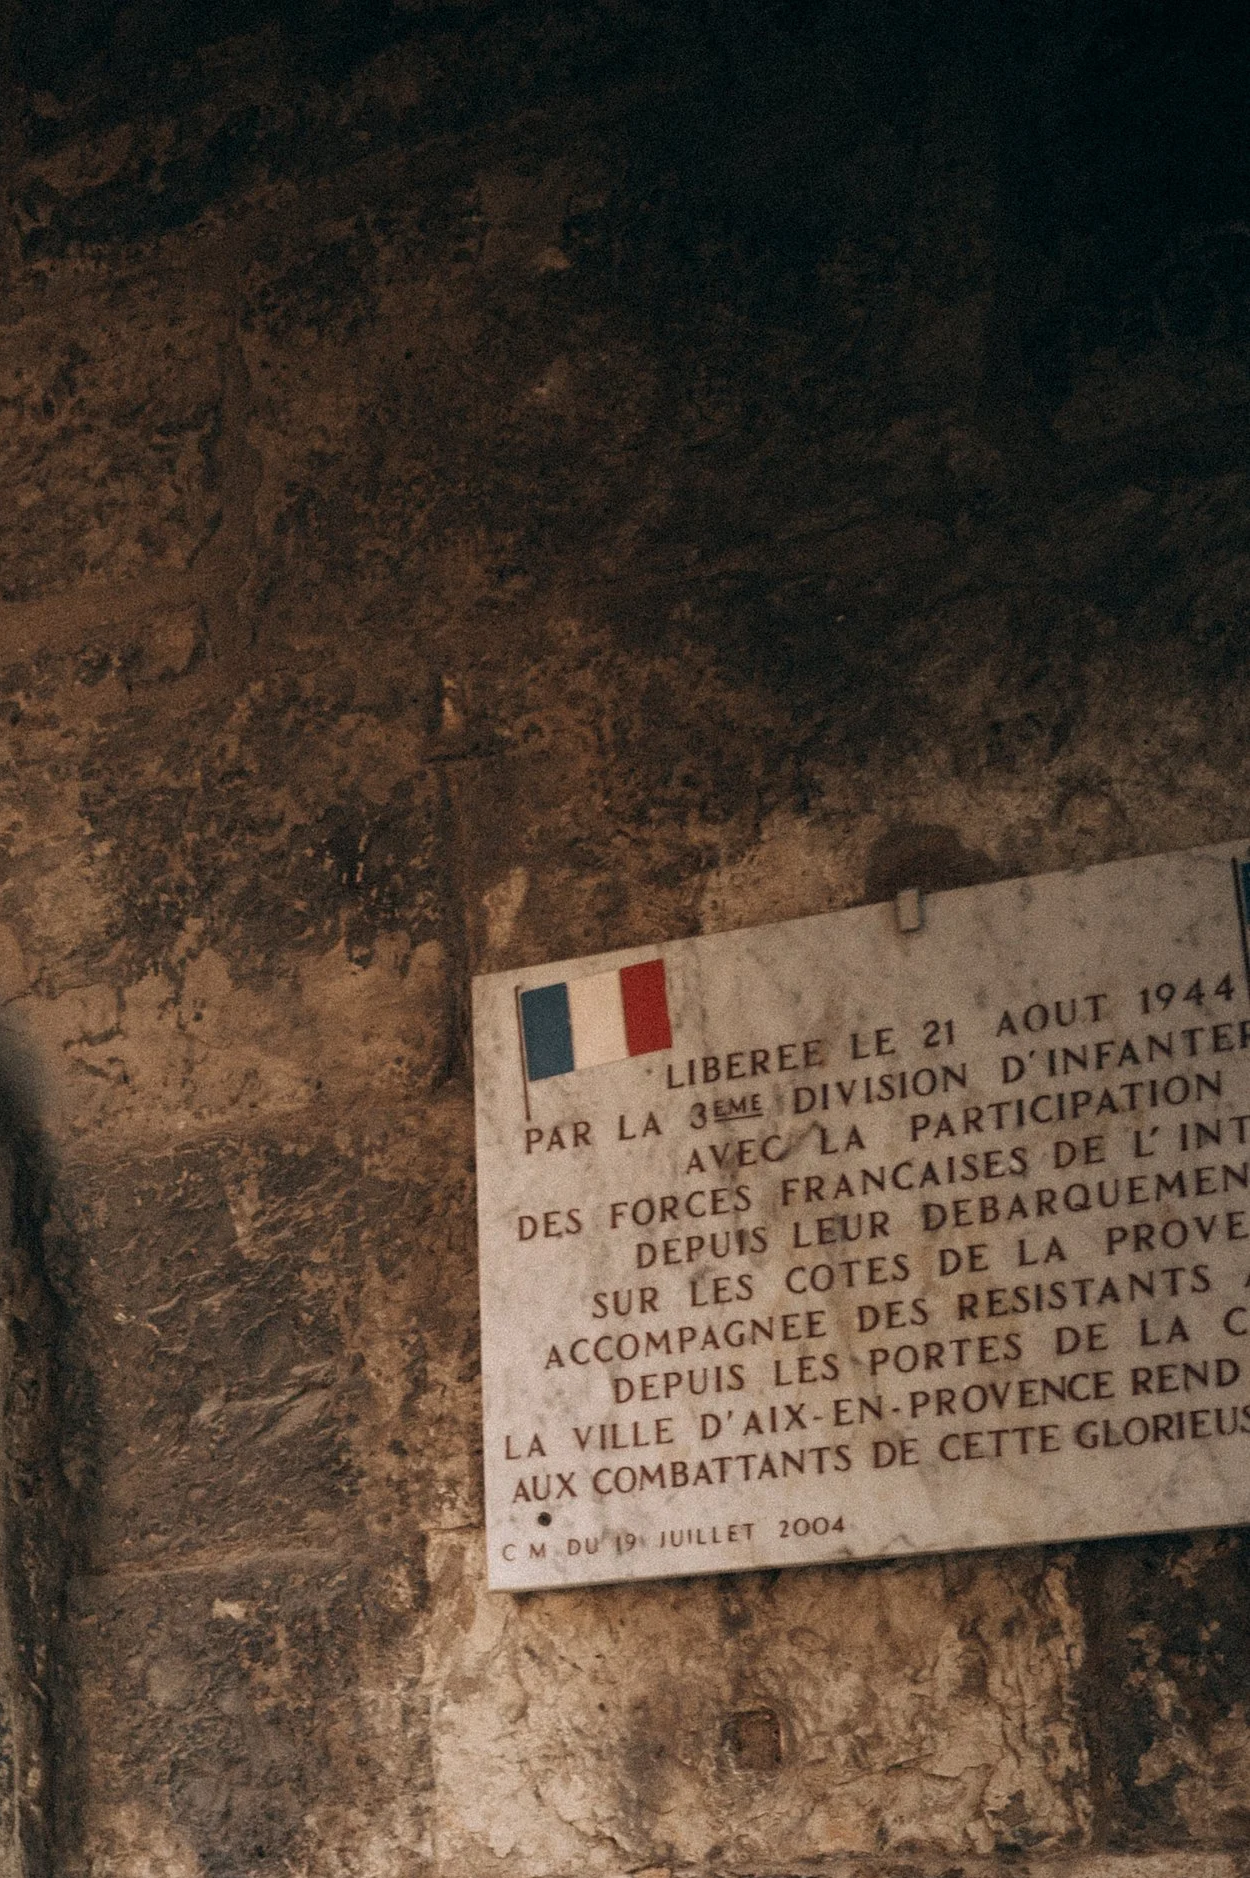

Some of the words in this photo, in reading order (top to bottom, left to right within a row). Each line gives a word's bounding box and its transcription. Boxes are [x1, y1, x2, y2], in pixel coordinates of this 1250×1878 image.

[667, 1040, 823, 1089] LIBEREE
[851, 1028, 896, 1060] LE
[923, 1019, 954, 1049] 21
[996, 994, 1107, 1037] AOUT
[1140, 971, 1234, 1015] 1944
[524, 1121, 592, 1154] PAR
[618, 1111, 662, 1141] LA
[793, 1063, 967, 1115] DIVISION
[686, 1135, 783, 1174] AVEC
[820, 1125, 865, 1155] LA
[910, 1071, 1222, 1142] PARTICIPATION
[518, 1209, 582, 1241] DES
[610, 1186, 751, 1229] FORCES
[781, 1147, 1028, 1206] FRANCAISES
[1054, 1136, 1105, 1169] DE
[637, 1226, 767, 1269] DEPUIS
[793, 1211, 890, 1249] LEUR
[922, 1161, 1249, 1232] DEBARQUEMEN
[544, 1310, 827, 1370] ACCOMPAGNEE
[857, 1298, 929, 1333] DES
[957, 1264, 1211, 1321] RESISTANTS
[591, 1287, 659, 1320] SUR
[690, 1274, 754, 1308] LES
[786, 1253, 910, 1295] COTES
[939, 1244, 989, 1277] DE
[1018, 1236, 1067, 1267] LA
[1105, 1211, 1249, 1255] PROVE
[504, 1433, 547, 1460] LA
[573, 1417, 674, 1452] VILLE
[1131, 1358, 1240, 1397] REND
[613, 1364, 746, 1404] DEPUIS
[774, 1353, 840, 1388] LES
[869, 1333, 1022, 1376] PORTES
[1055, 1323, 1109, 1355] DE
[1140, 1315, 1190, 1347] LA
[512, 1472, 578, 1503] AUX
[593, 1444, 851, 1496] COMBATTANTS
[873, 1438, 919, 1469] DE
[938, 1424, 1060, 1462] CETTE
[567, 1537, 599, 1555] DU
[616, 1533, 637, 1555] 19
[660, 1522, 755, 1548] JUILLET
[779, 1516, 845, 1538] 2004
